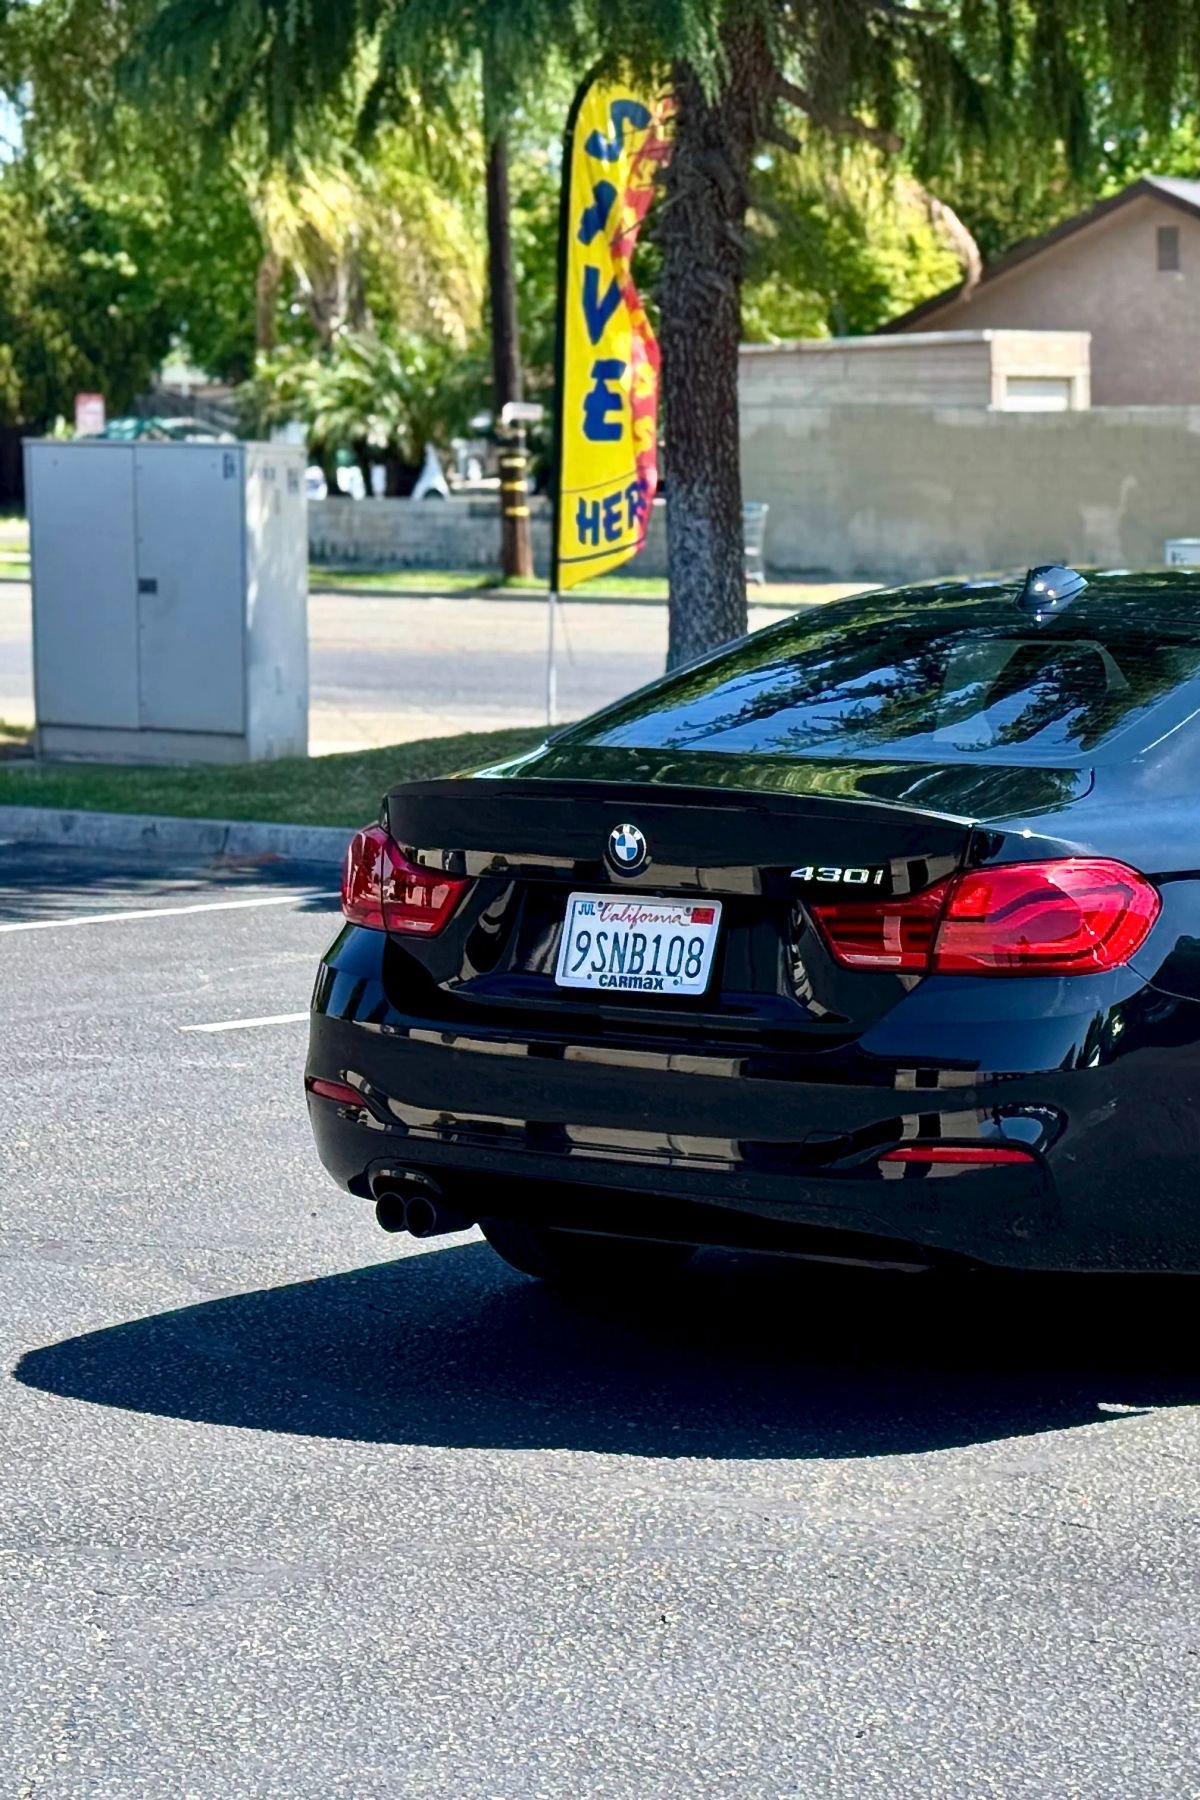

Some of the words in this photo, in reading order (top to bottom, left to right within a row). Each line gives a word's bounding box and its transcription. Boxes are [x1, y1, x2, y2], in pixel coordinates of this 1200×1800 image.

[577, 98, 651, 441] SAVE
[576, 478, 649, 546] HER
[577, 903, 596, 916] JUL
[600, 902, 690, 930] California
[571, 930, 705, 979] 9SNB108
